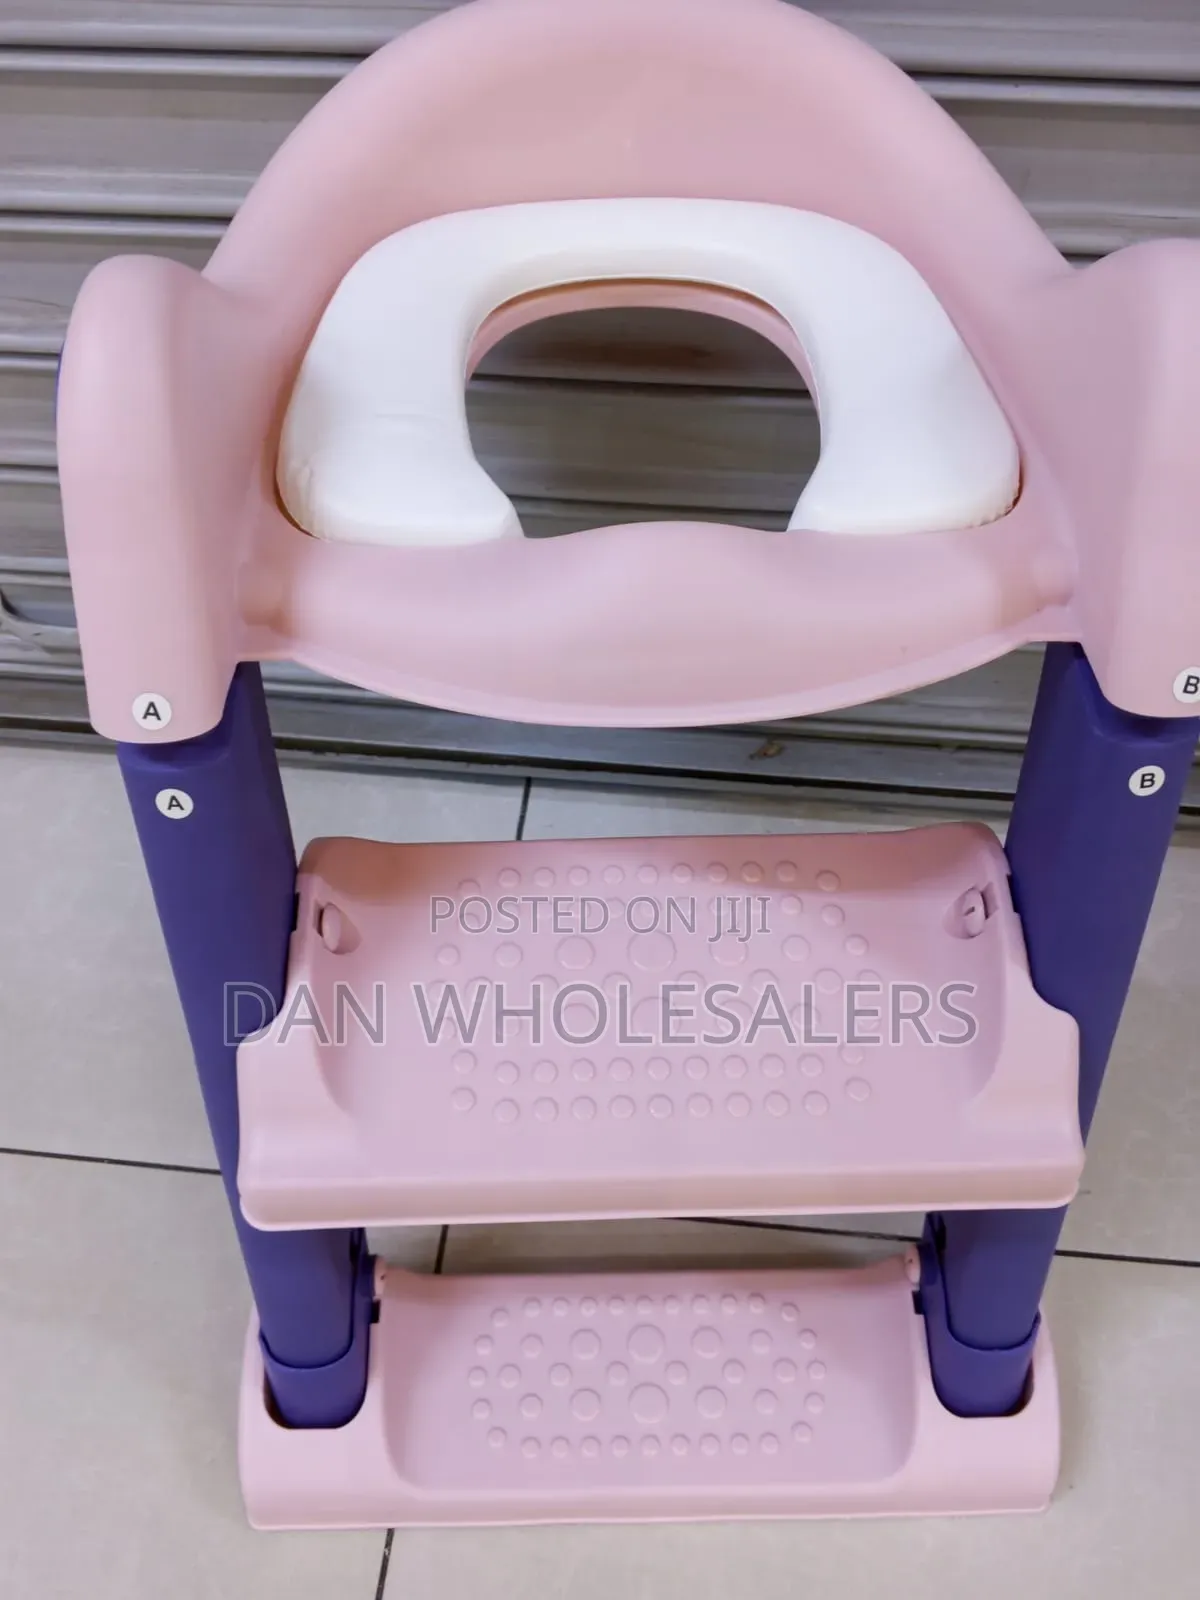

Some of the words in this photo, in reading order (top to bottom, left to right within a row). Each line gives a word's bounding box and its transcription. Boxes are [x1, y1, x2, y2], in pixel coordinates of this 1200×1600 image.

[1182, 674, 1200, 695] B
[142, 701, 162, 721] A
[1139, 772, 1156, 789] B
[166, 795, 185, 811] A
